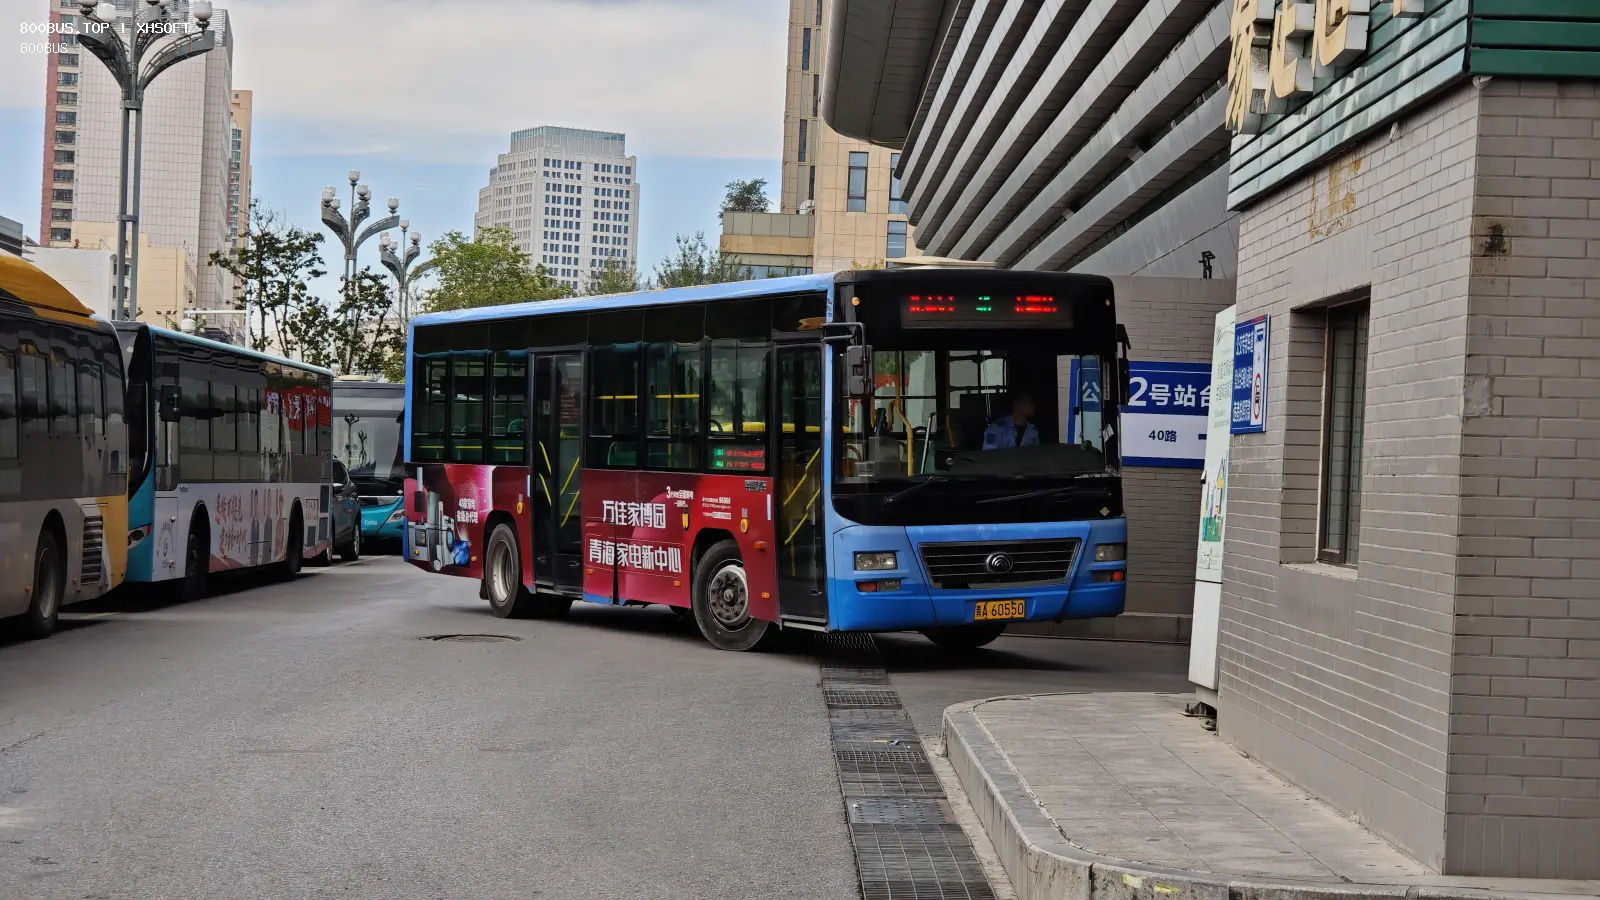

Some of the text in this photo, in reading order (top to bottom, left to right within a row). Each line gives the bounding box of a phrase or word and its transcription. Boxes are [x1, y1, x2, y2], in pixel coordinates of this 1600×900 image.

[1148, 429, 1177, 443] 40路
[602, 499, 667, 529] 万佳家博园
[588, 537, 682, 574] 青海家电新中心
[991, 602, 1024, 617] 60550
